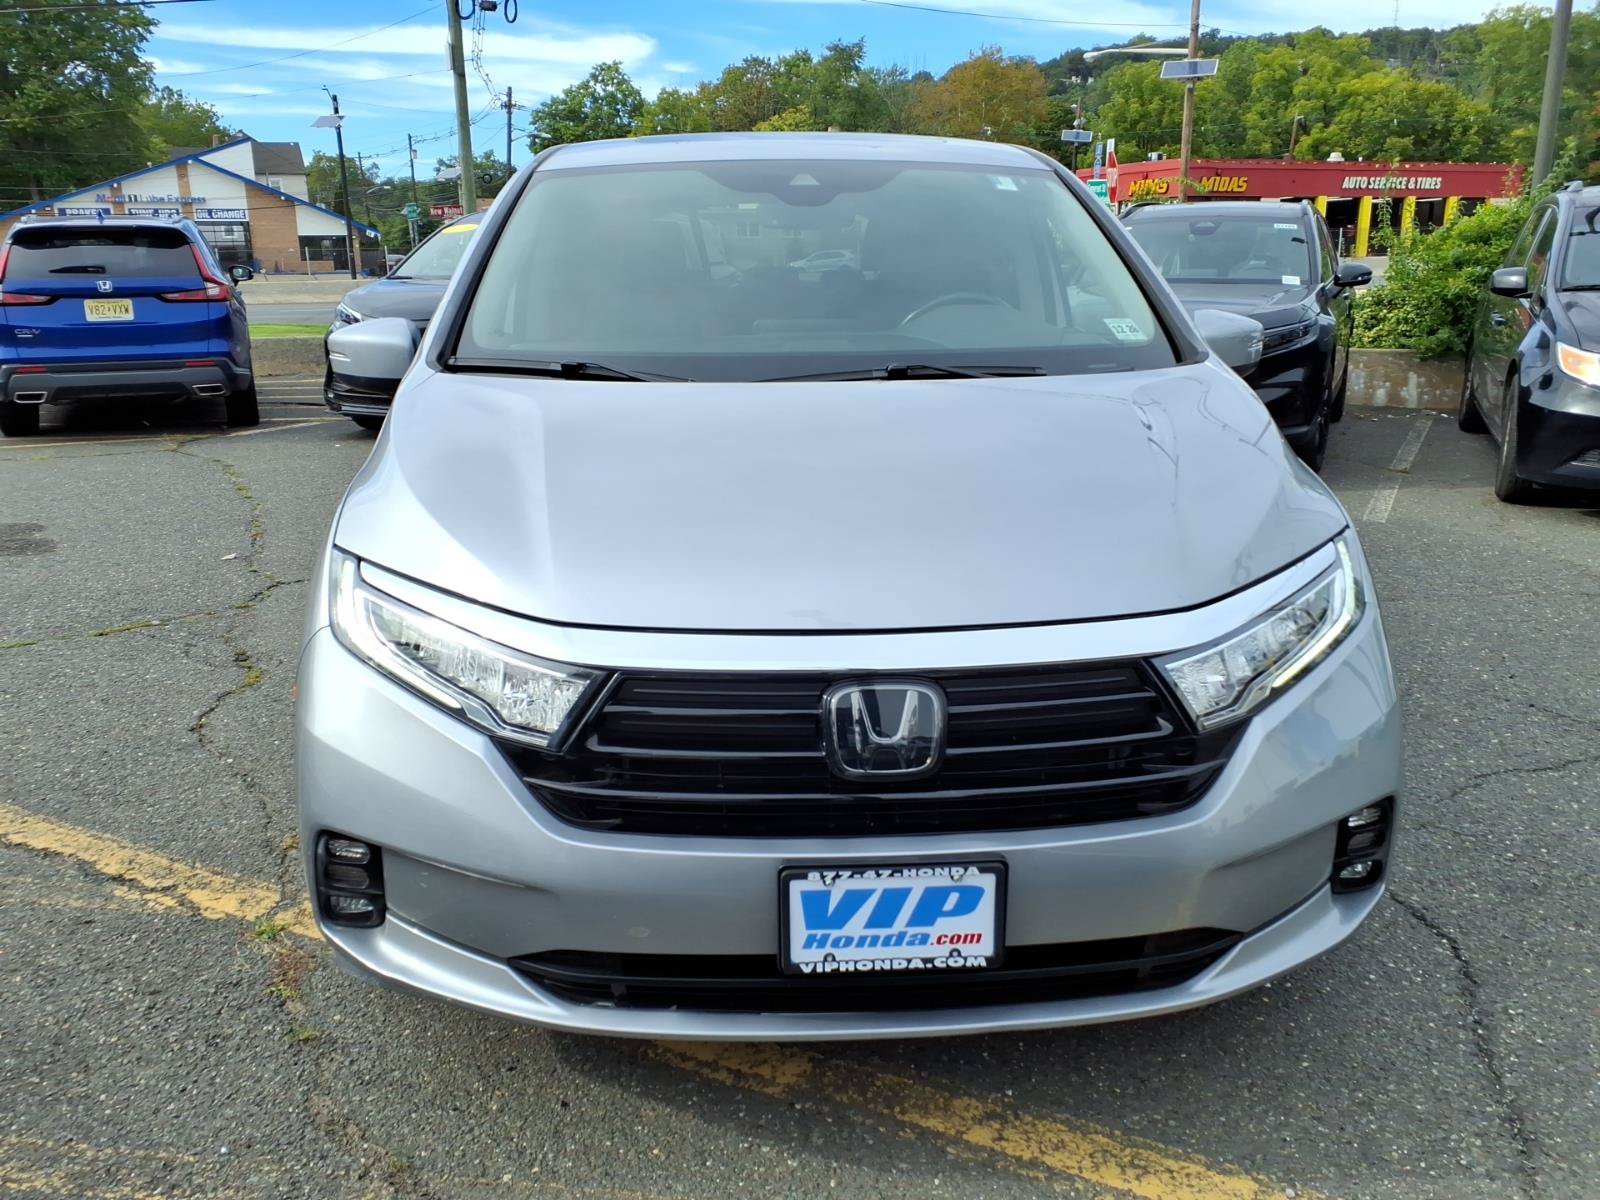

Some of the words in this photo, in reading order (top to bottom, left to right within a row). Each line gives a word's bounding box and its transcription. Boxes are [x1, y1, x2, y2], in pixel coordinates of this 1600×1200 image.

[1200, 176, 1248, 192] MIDAS
[1342, 176, 1368, 189] AUTO
[1416, 177, 1442, 189] TIRES
[197, 209, 210, 219] OIL
[211, 209, 245, 219] CHANGE
[800, 885, 986, 931] VIP
[800, 956, 987, 974] VIPHONDA.COM
